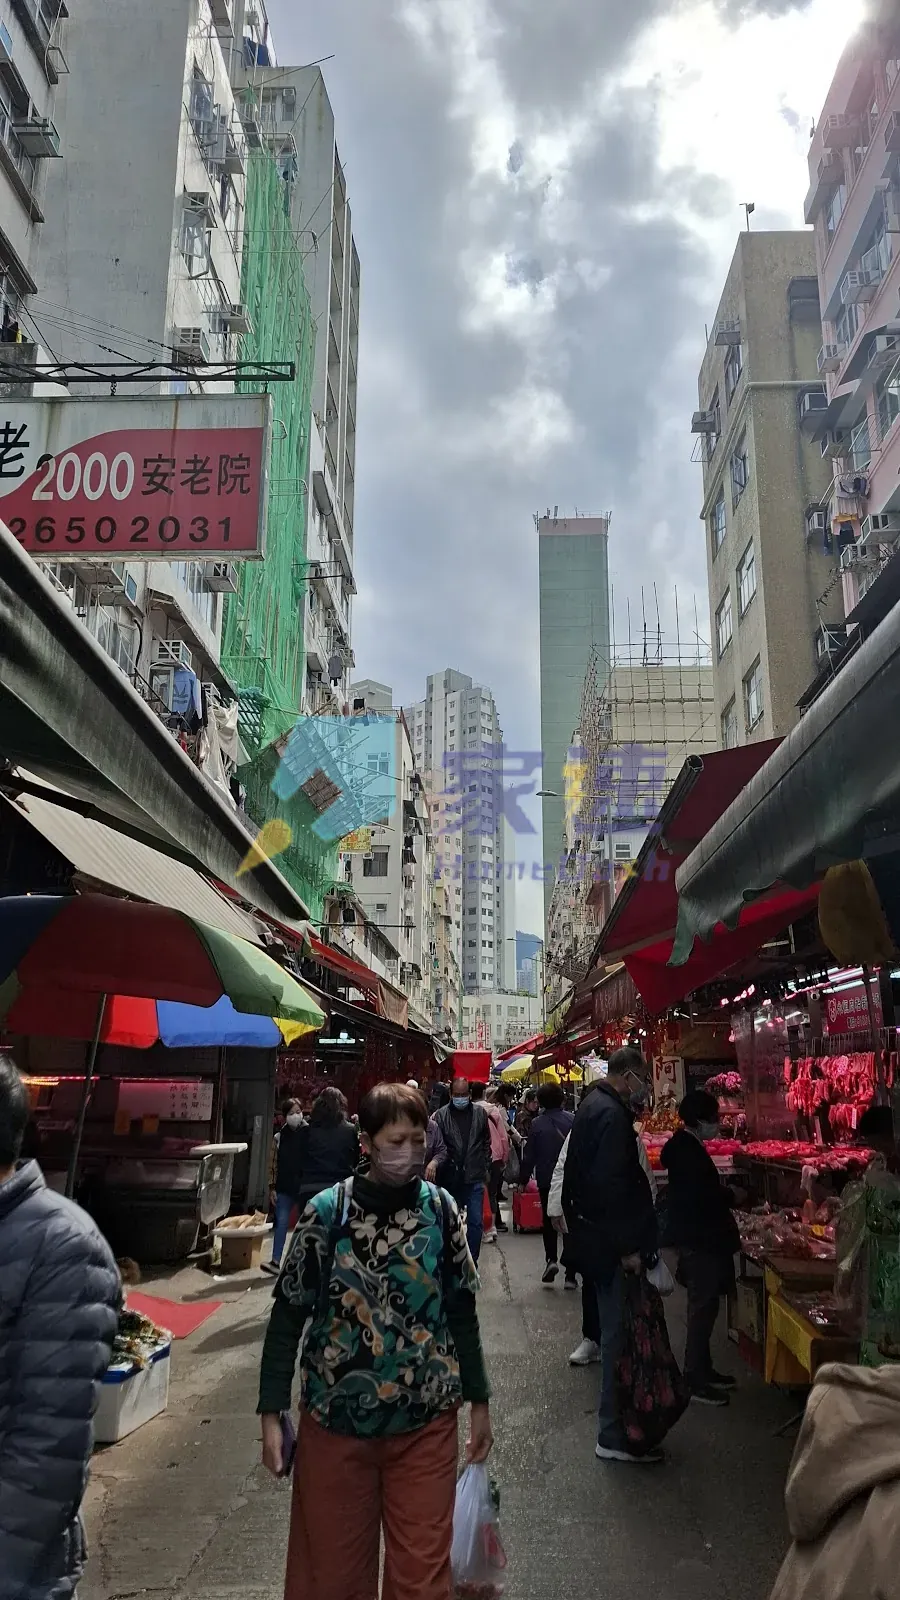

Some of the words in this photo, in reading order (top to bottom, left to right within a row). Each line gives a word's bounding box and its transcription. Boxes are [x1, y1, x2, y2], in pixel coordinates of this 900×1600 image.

[32, 452, 135, 501] 2000
[141, 454, 251, 496] 安老院
